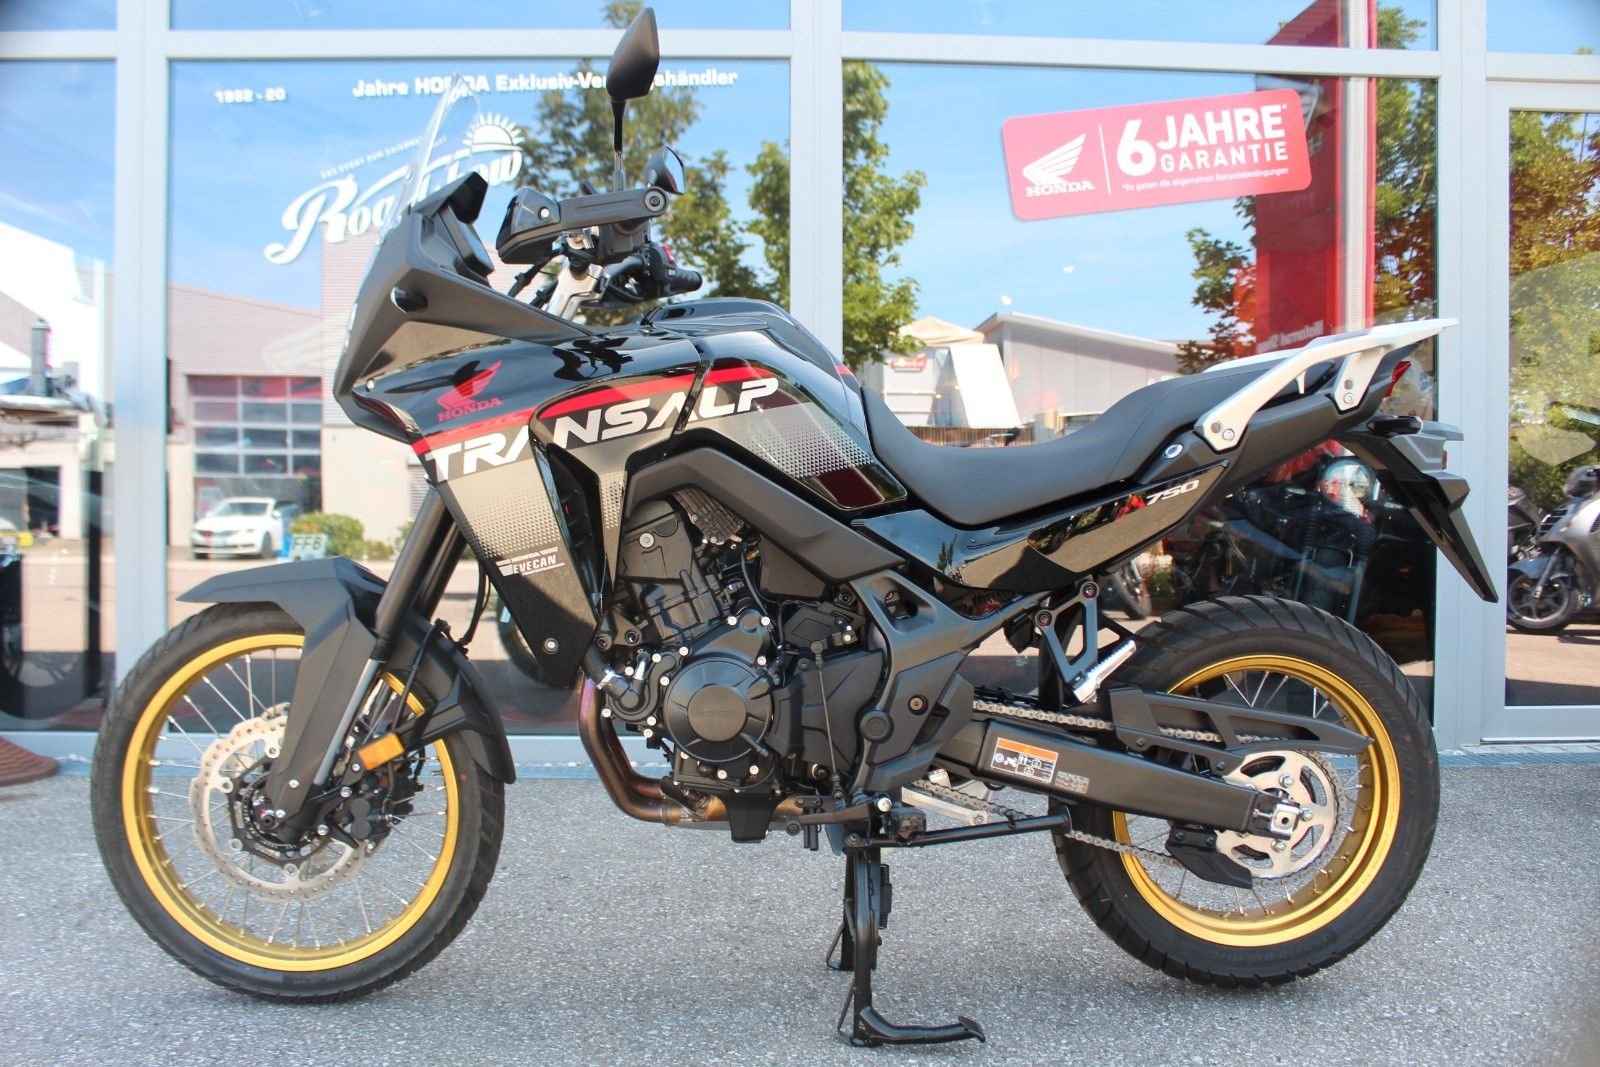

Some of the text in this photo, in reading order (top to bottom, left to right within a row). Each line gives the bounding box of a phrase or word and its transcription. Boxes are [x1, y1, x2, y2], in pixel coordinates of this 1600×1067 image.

[353, 80, 409, 97] Jahre
[1117, 119, 1157, 176] 6
[1160, 141, 1288, 173] GARANTIE
[1025, 180, 1096, 197] HONDA
[437, 397, 503, 422] HONDA
[1146, 479, 1200, 506] 750
